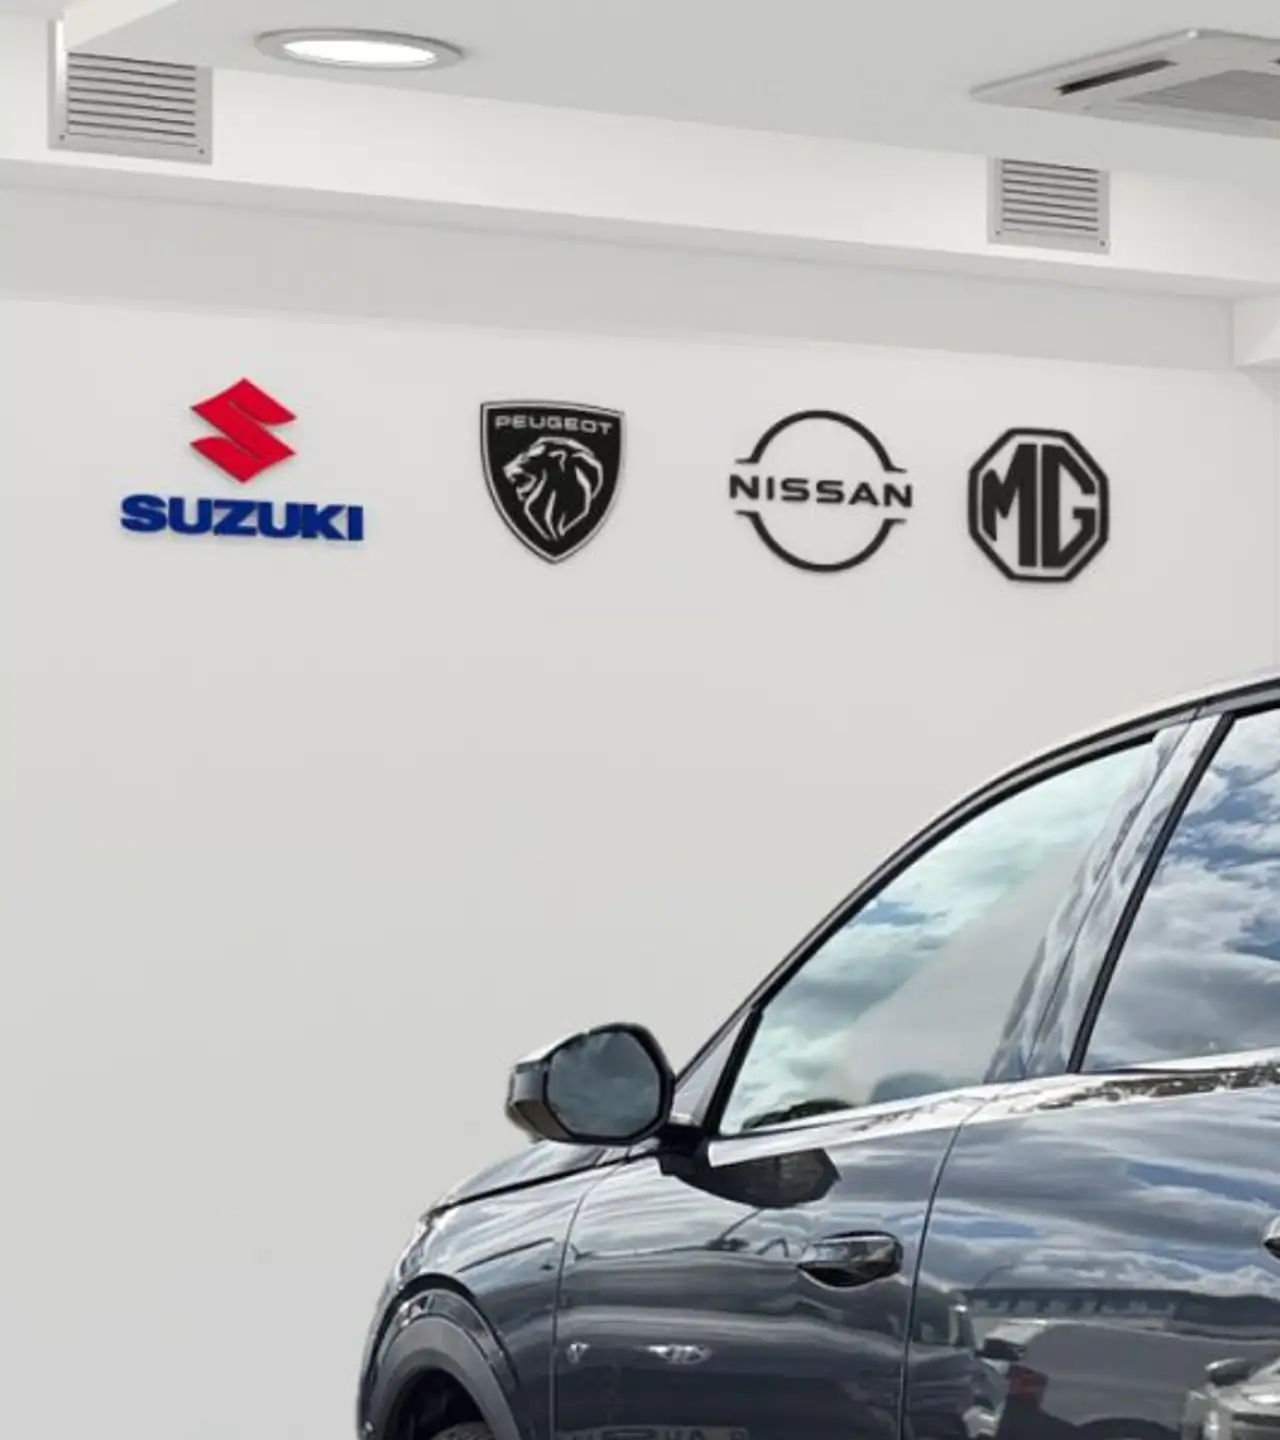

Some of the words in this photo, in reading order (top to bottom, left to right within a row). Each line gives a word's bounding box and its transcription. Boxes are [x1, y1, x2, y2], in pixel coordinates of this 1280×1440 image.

[494, 413, 614, 436] PEUGEOT
[729, 474, 913, 508] NISSAN
[981, 442, 1097, 568] MG
[121, 493, 364, 540] SUZUKI
